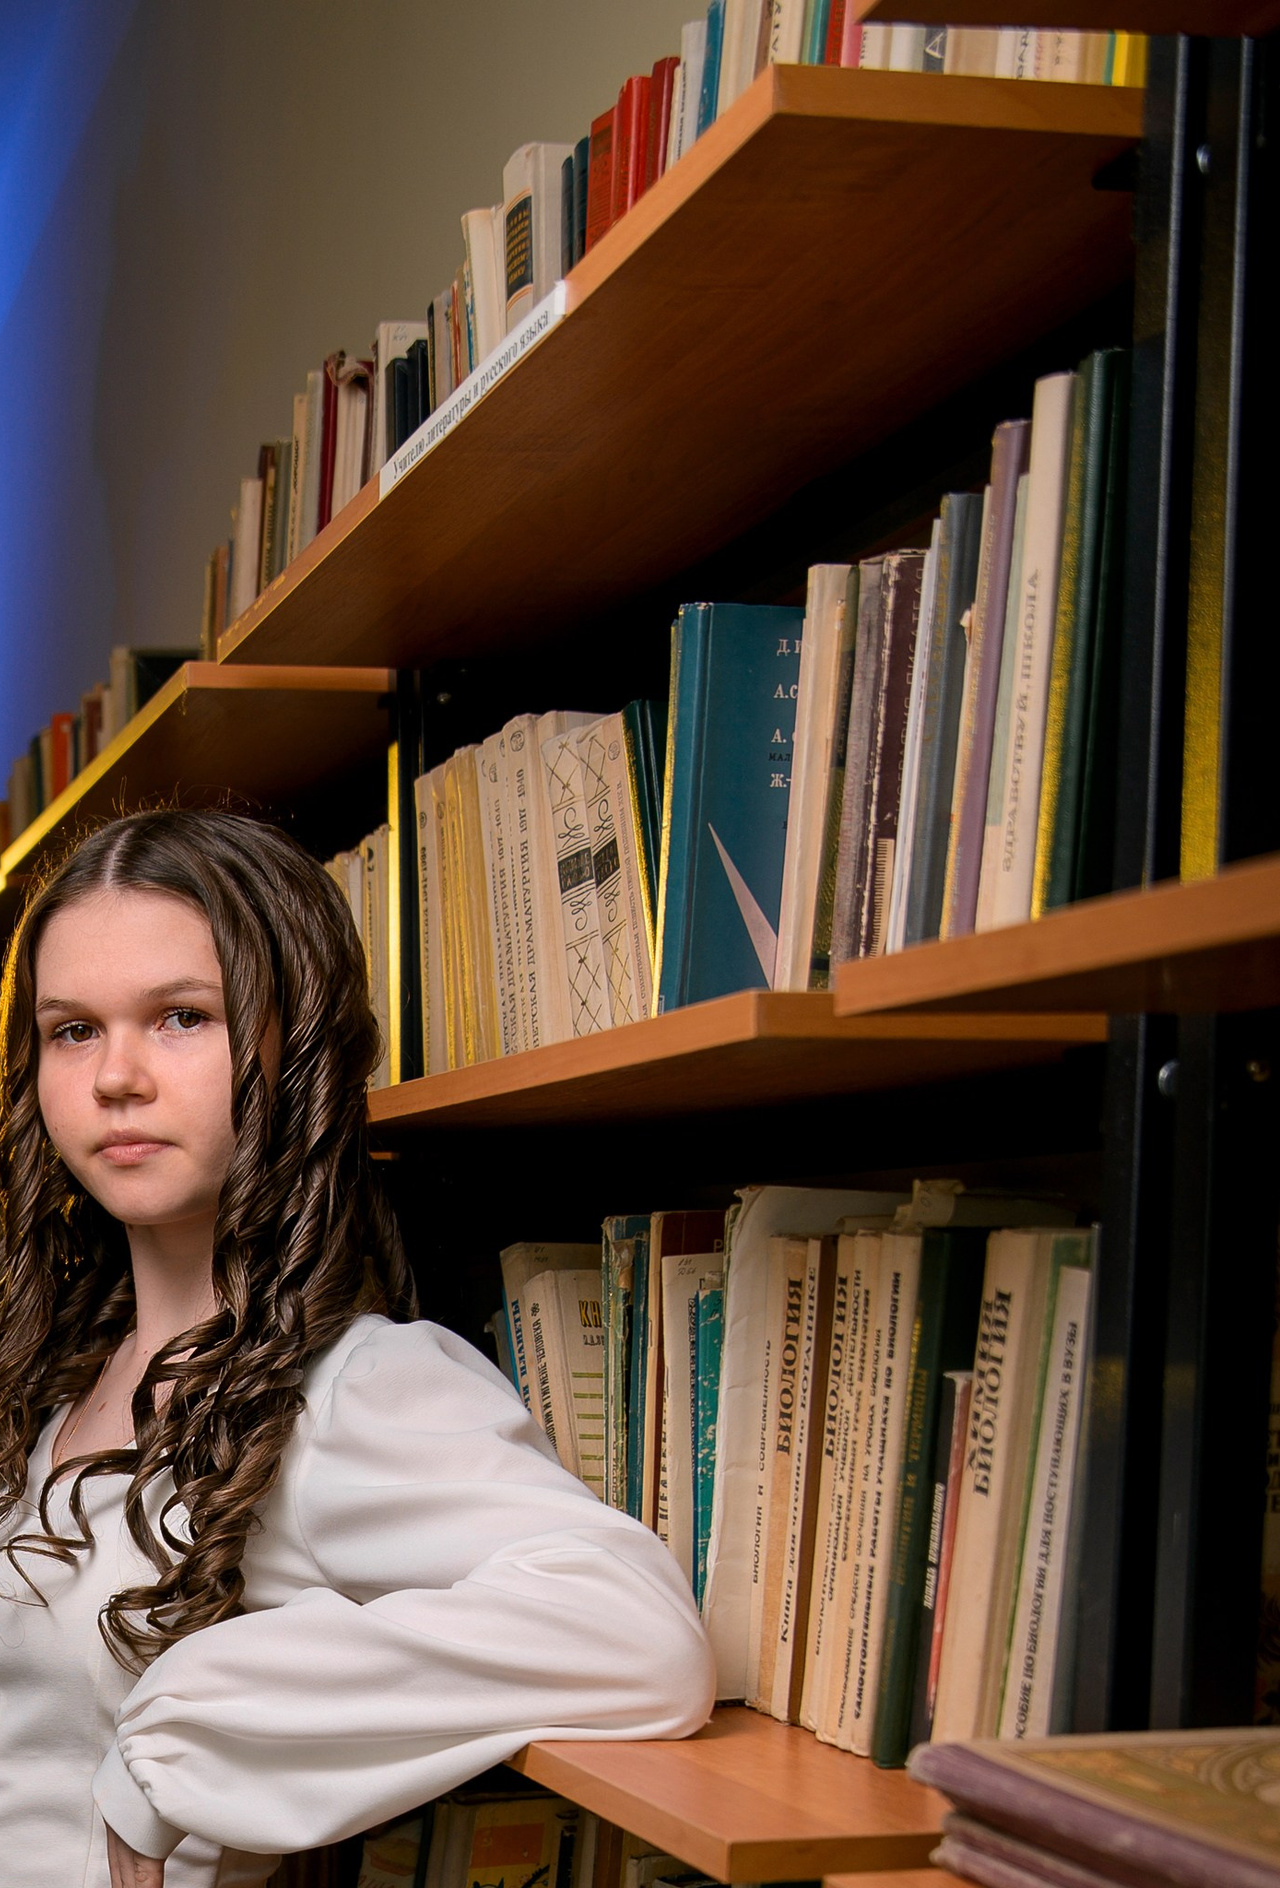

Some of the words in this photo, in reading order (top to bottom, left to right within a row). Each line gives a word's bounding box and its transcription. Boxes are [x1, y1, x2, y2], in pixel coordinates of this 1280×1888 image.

[393, 438, 424, 479] Учителю
[425, 392, 472, 447] литературы
[480, 342, 519, 398] русского
[519, 310, 549, 354] языка
[1020, 567, 1038, 679] ШКОЛА
[497, 867, 515, 987] ДРАМАТУРГИЯ
[519, 839, 535, 965] ДРАМАТУРГИЯ
[528, 970, 540, 1048] ВЕТСКАЯ
[531, 1318, 546, 1362] ЧЕЛОВЕКА
[774, 1277, 803, 1455] БИОЛОГИЯ
[823, 1274, 848, 1459] БИОЛОГИЯ
[838, 1409, 850, 1481] УЧЕБНОЙ
[845, 1268, 861, 1396] ДЕЯТЕЛЬНОСТИ
[970, 1287, 1012, 1498] БИОЛОГИЯ
[1062, 1320, 1078, 1370] ВУЗЫ
[758, 1339, 771, 1471] СОВРЕМЕННОСТЬ
[780, 1578, 793, 1643] Книга
[791, 1451, 802, 1526] чтения
[799, 1266, 816, 1409] БОТАНИКЕ
[851, 1389, 862, 1433] УРОК
[1042, 1388, 1069, 1524] ПОСТУПАЮЩИХ
[848, 1563, 860, 1619] СРЕДСТВ
[863, 1403, 875, 1455] УРОКАХ
[869, 1328, 882, 1397] БИОЛОГИИ
[853, 1564, 874, 1720] САМОСТОЯТЕЛЬНЫЕ
[868, 1490, 882, 1558] РАБОТЫ
[875, 1394, 890, 1485] УЧАЩИХСЯ
[886, 1271, 901, 1359] БИОЛОГИИ
[1037, 1528, 1052, 1563] ДЛЯ
[1021, 1654, 1035, 1679] ПО
[1025, 1565, 1046, 1653] БИОЛОГИИ
[1013, 1680, 1032, 1739] СОБИЕ
